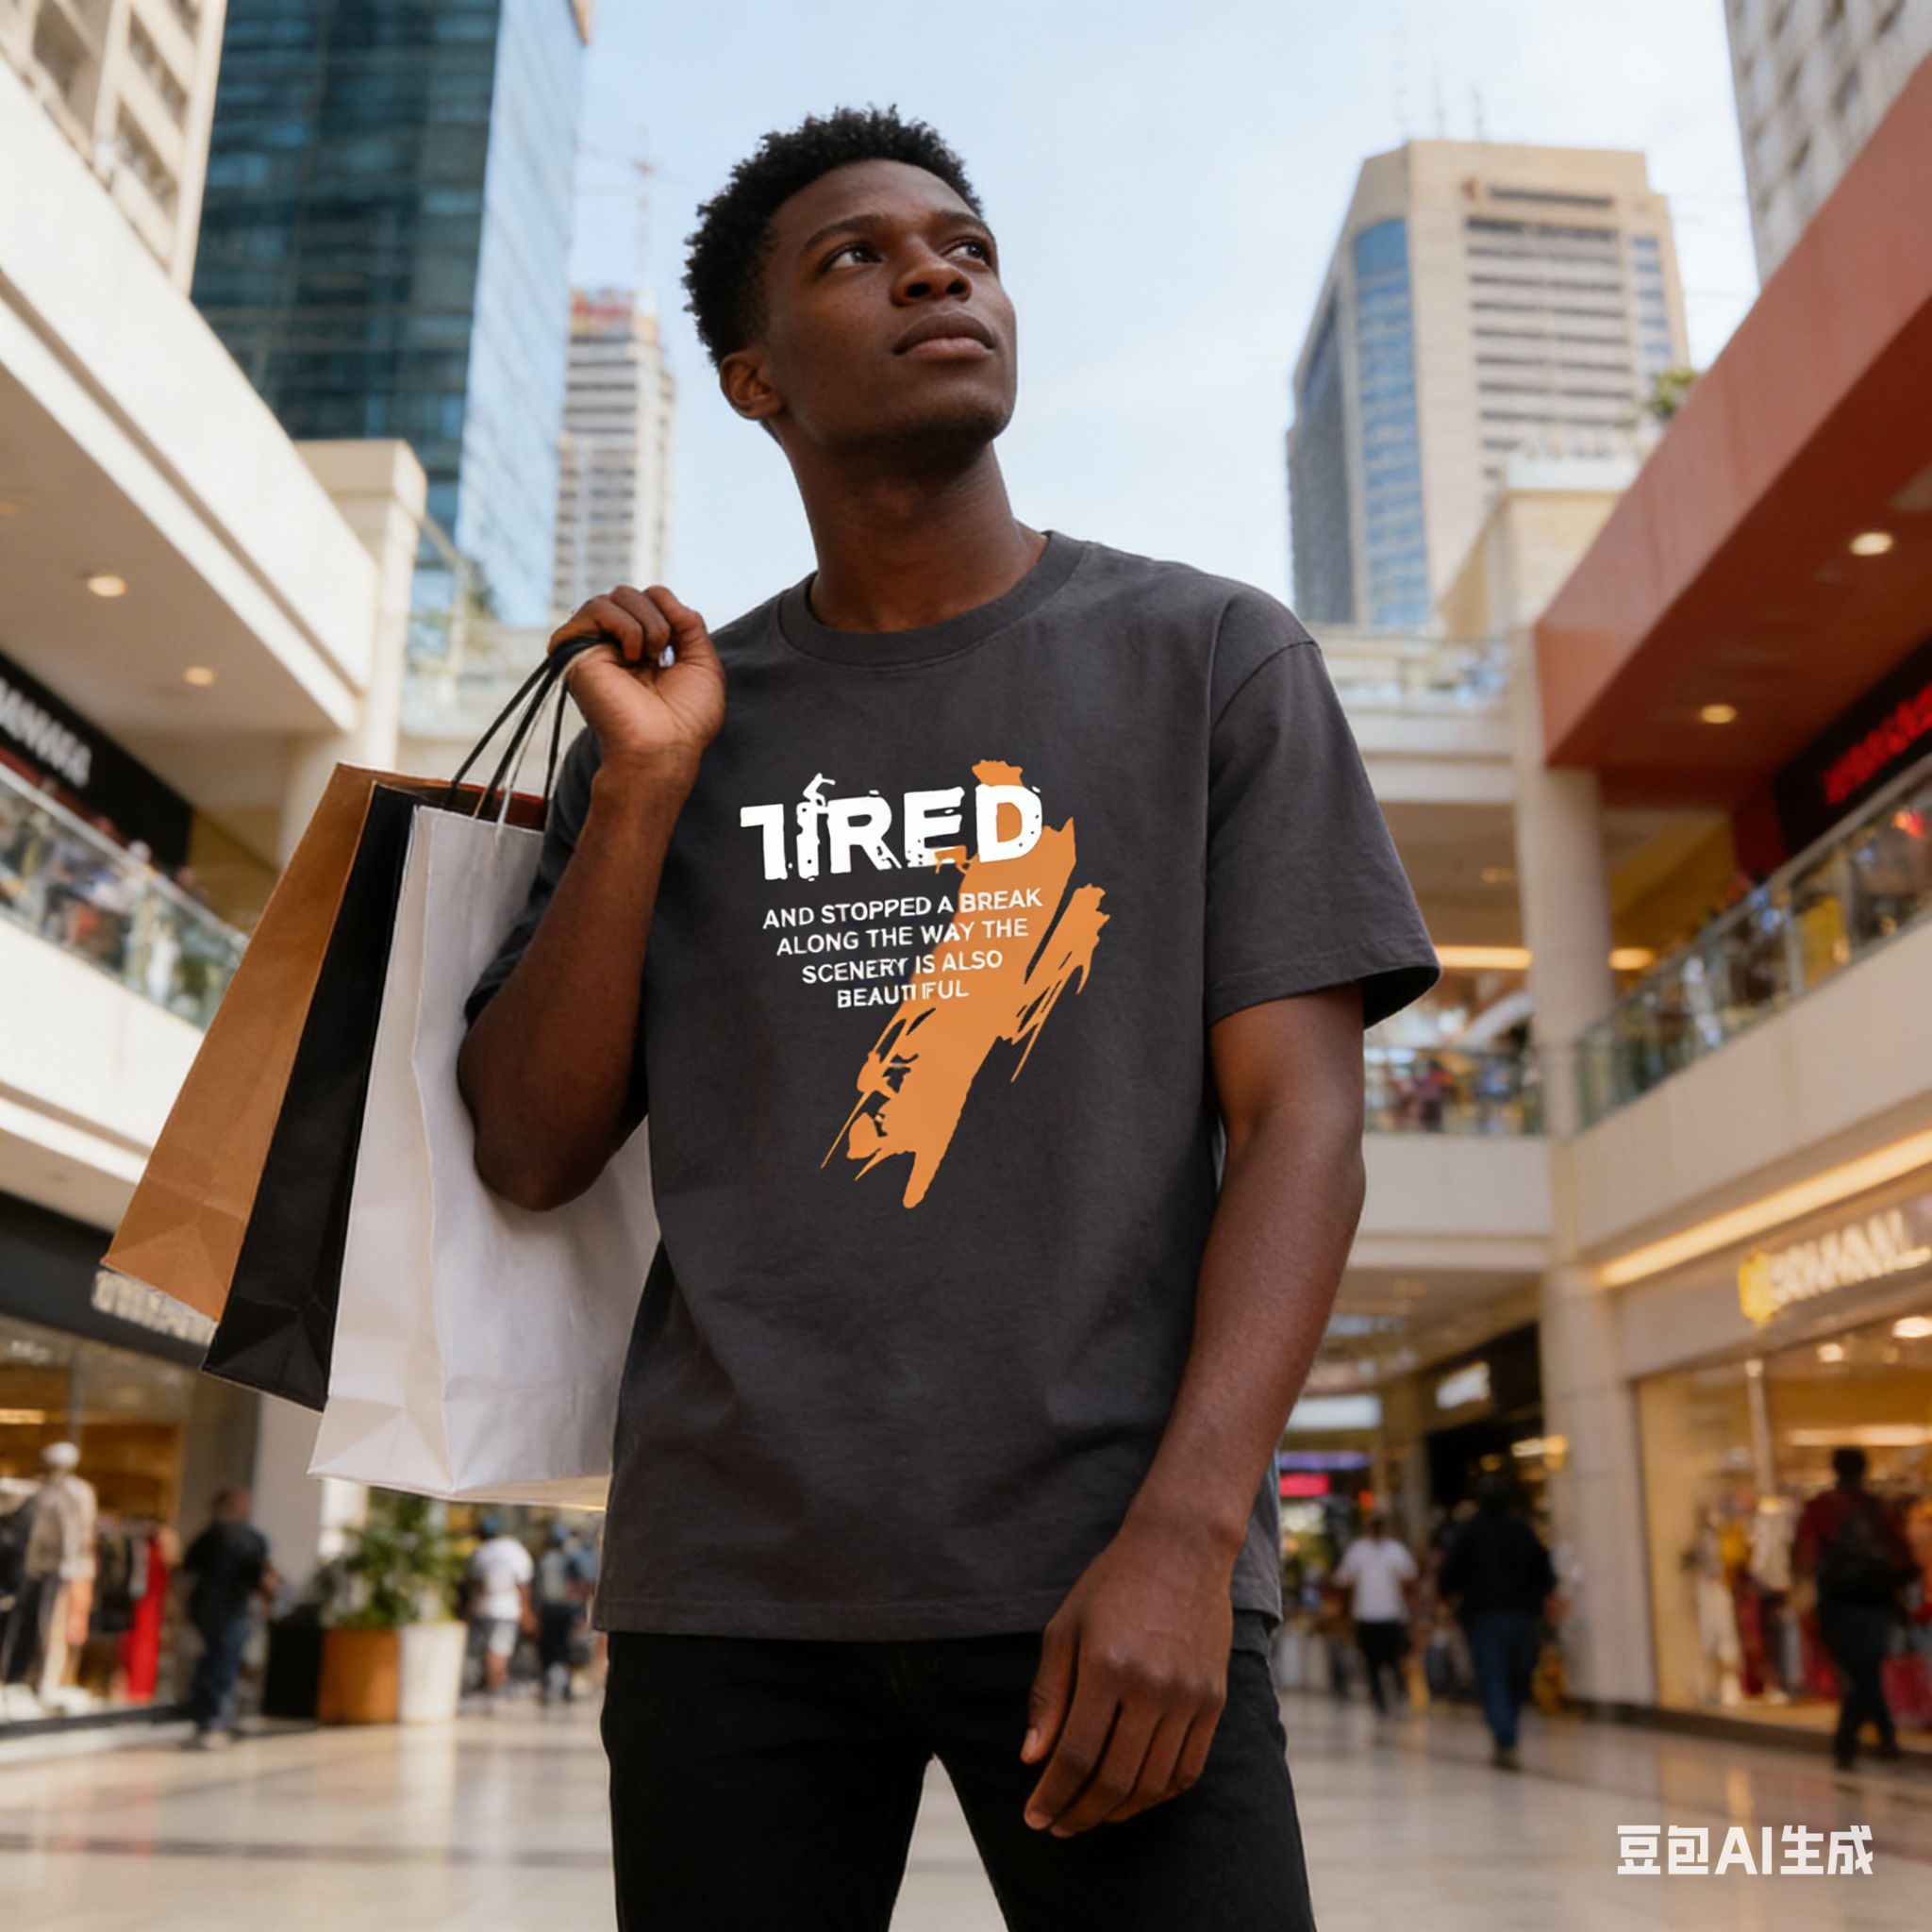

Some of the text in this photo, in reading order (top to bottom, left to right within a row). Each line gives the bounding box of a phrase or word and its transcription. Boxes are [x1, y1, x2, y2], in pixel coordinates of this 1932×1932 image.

[762, 888, 1042, 930] AND STOPPED A BREAK
[776, 918, 1029, 957] ALONG THE WAY THE
[802, 950, 1003, 984] SCENERY IS ALSO
